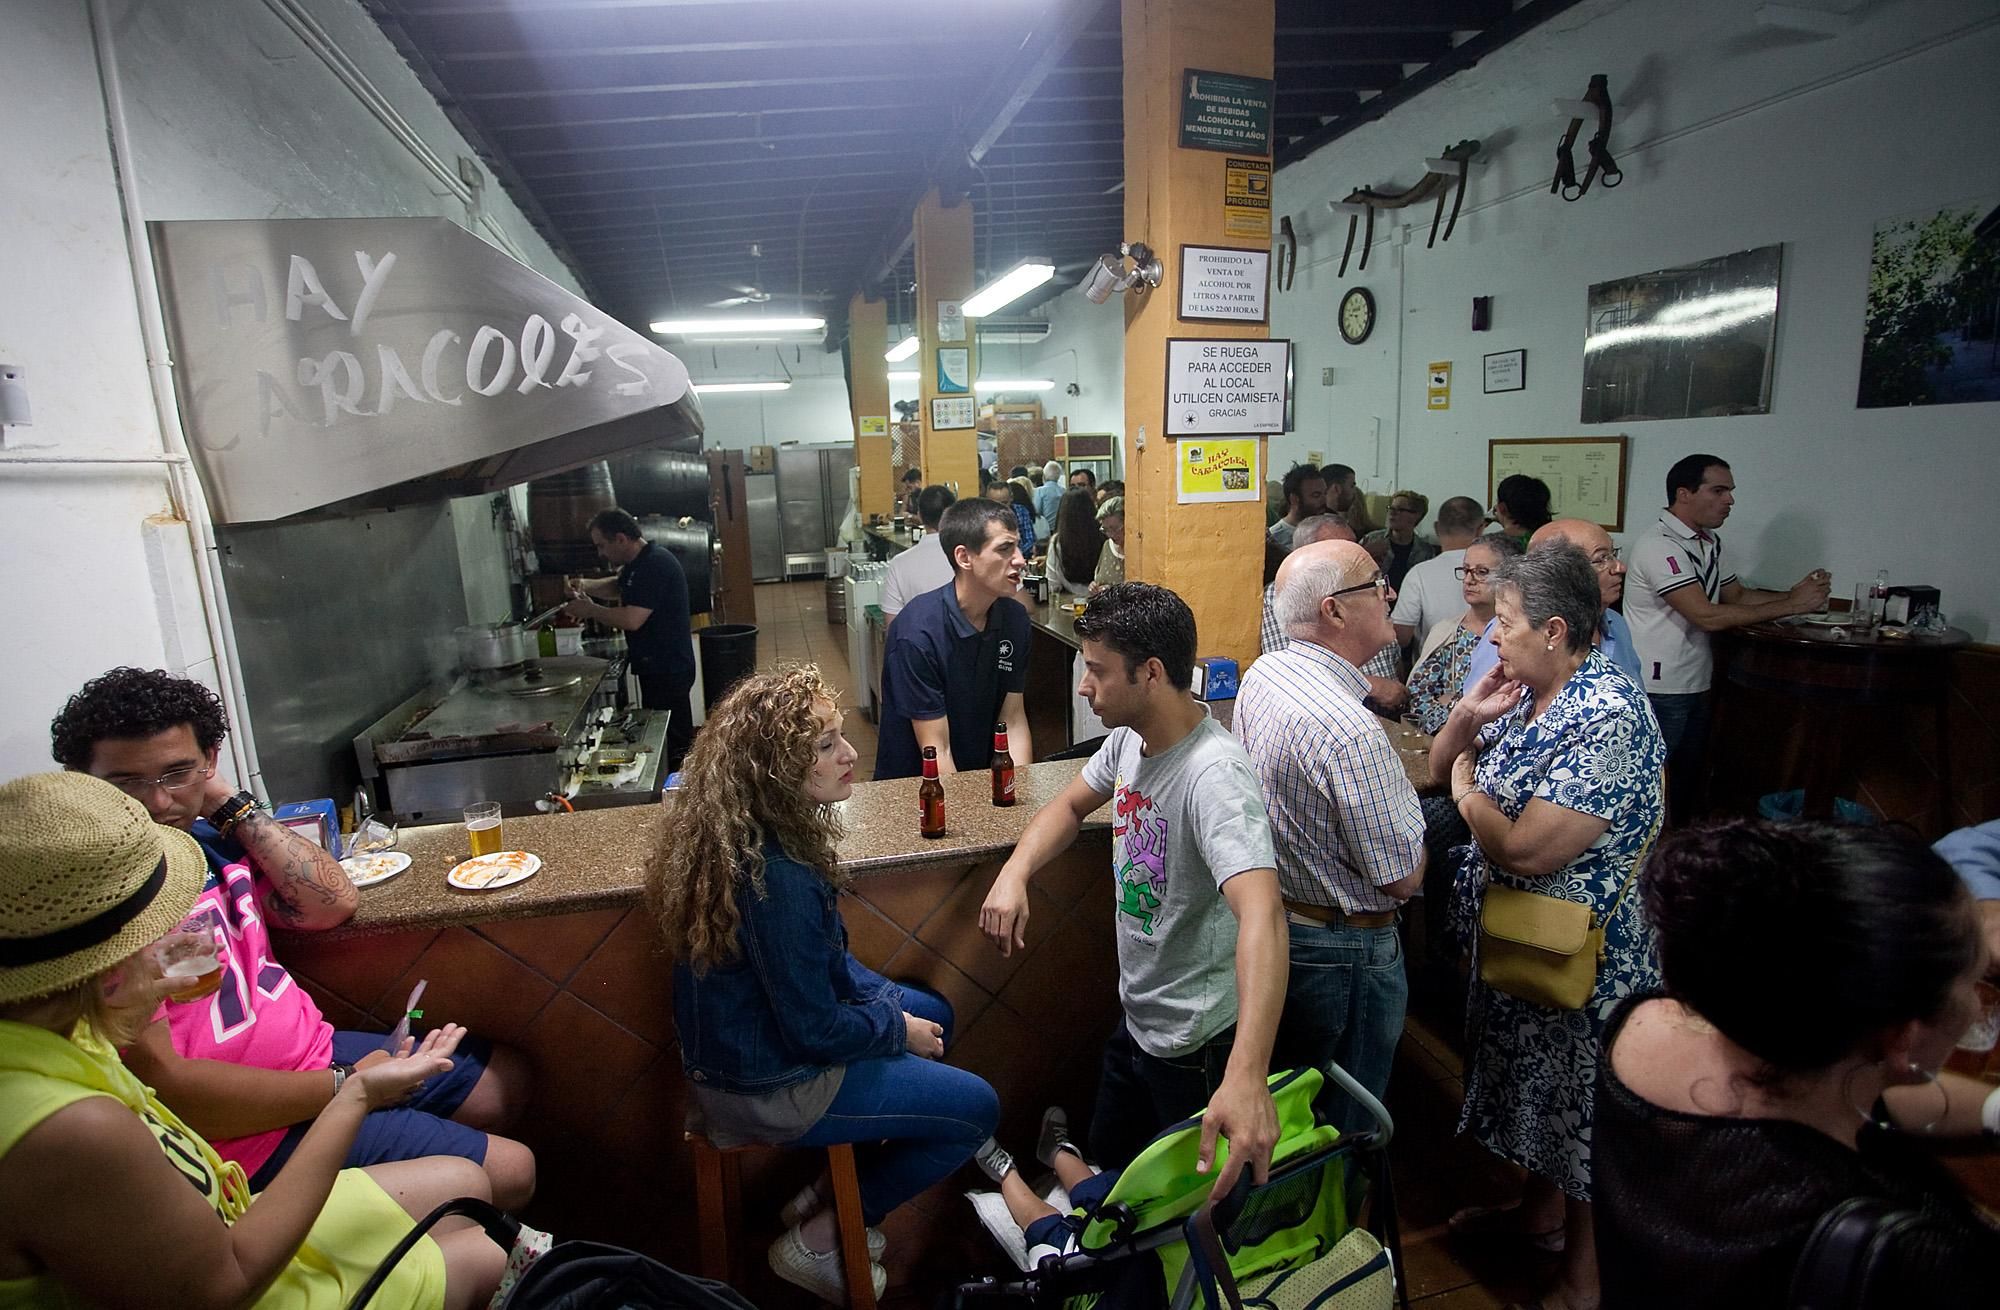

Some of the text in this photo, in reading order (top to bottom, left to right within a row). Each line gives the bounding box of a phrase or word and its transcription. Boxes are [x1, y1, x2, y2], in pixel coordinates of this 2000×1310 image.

[1189, 92, 1267, 109] PROHIBIDA LA VENTA
[1206, 105, 1250, 117] DE BEBIDAS
[1197, 115, 1249, 128] ALCOHÓLICAS
[1185, 124, 1222, 135] MENORES
[1246, 130, 1266, 140] AÑOS
[1227, 160, 1269, 170] CONECTADA
[1226, 197, 1269, 208] PROSEGUR
[1199, 255, 1242, 264] PROHIBIDO
[1207, 268, 1245, 277] VENTA DE
[1199, 280, 1235, 289] ALCOHOL
[211, 250, 398, 337] HAY
[1193, 292, 1220, 300] LITROS
[1228, 294, 1256, 302] PARTIR
[1232, 306, 1259, 314] HORAS
[1202, 346, 1259, 358] SE RUEGA
[1188, 362, 1272, 373] PARA ACCEDER
[1203, 377, 1255, 388] AL LOCAL
[1173, 392, 1283, 404] UTILICEN CAMISETA.
[1208, 409, 1247, 417] GRACIAS
[1208, 448, 1229, 464] HAY
[1191, 456, 1248, 476] CARACOLES
